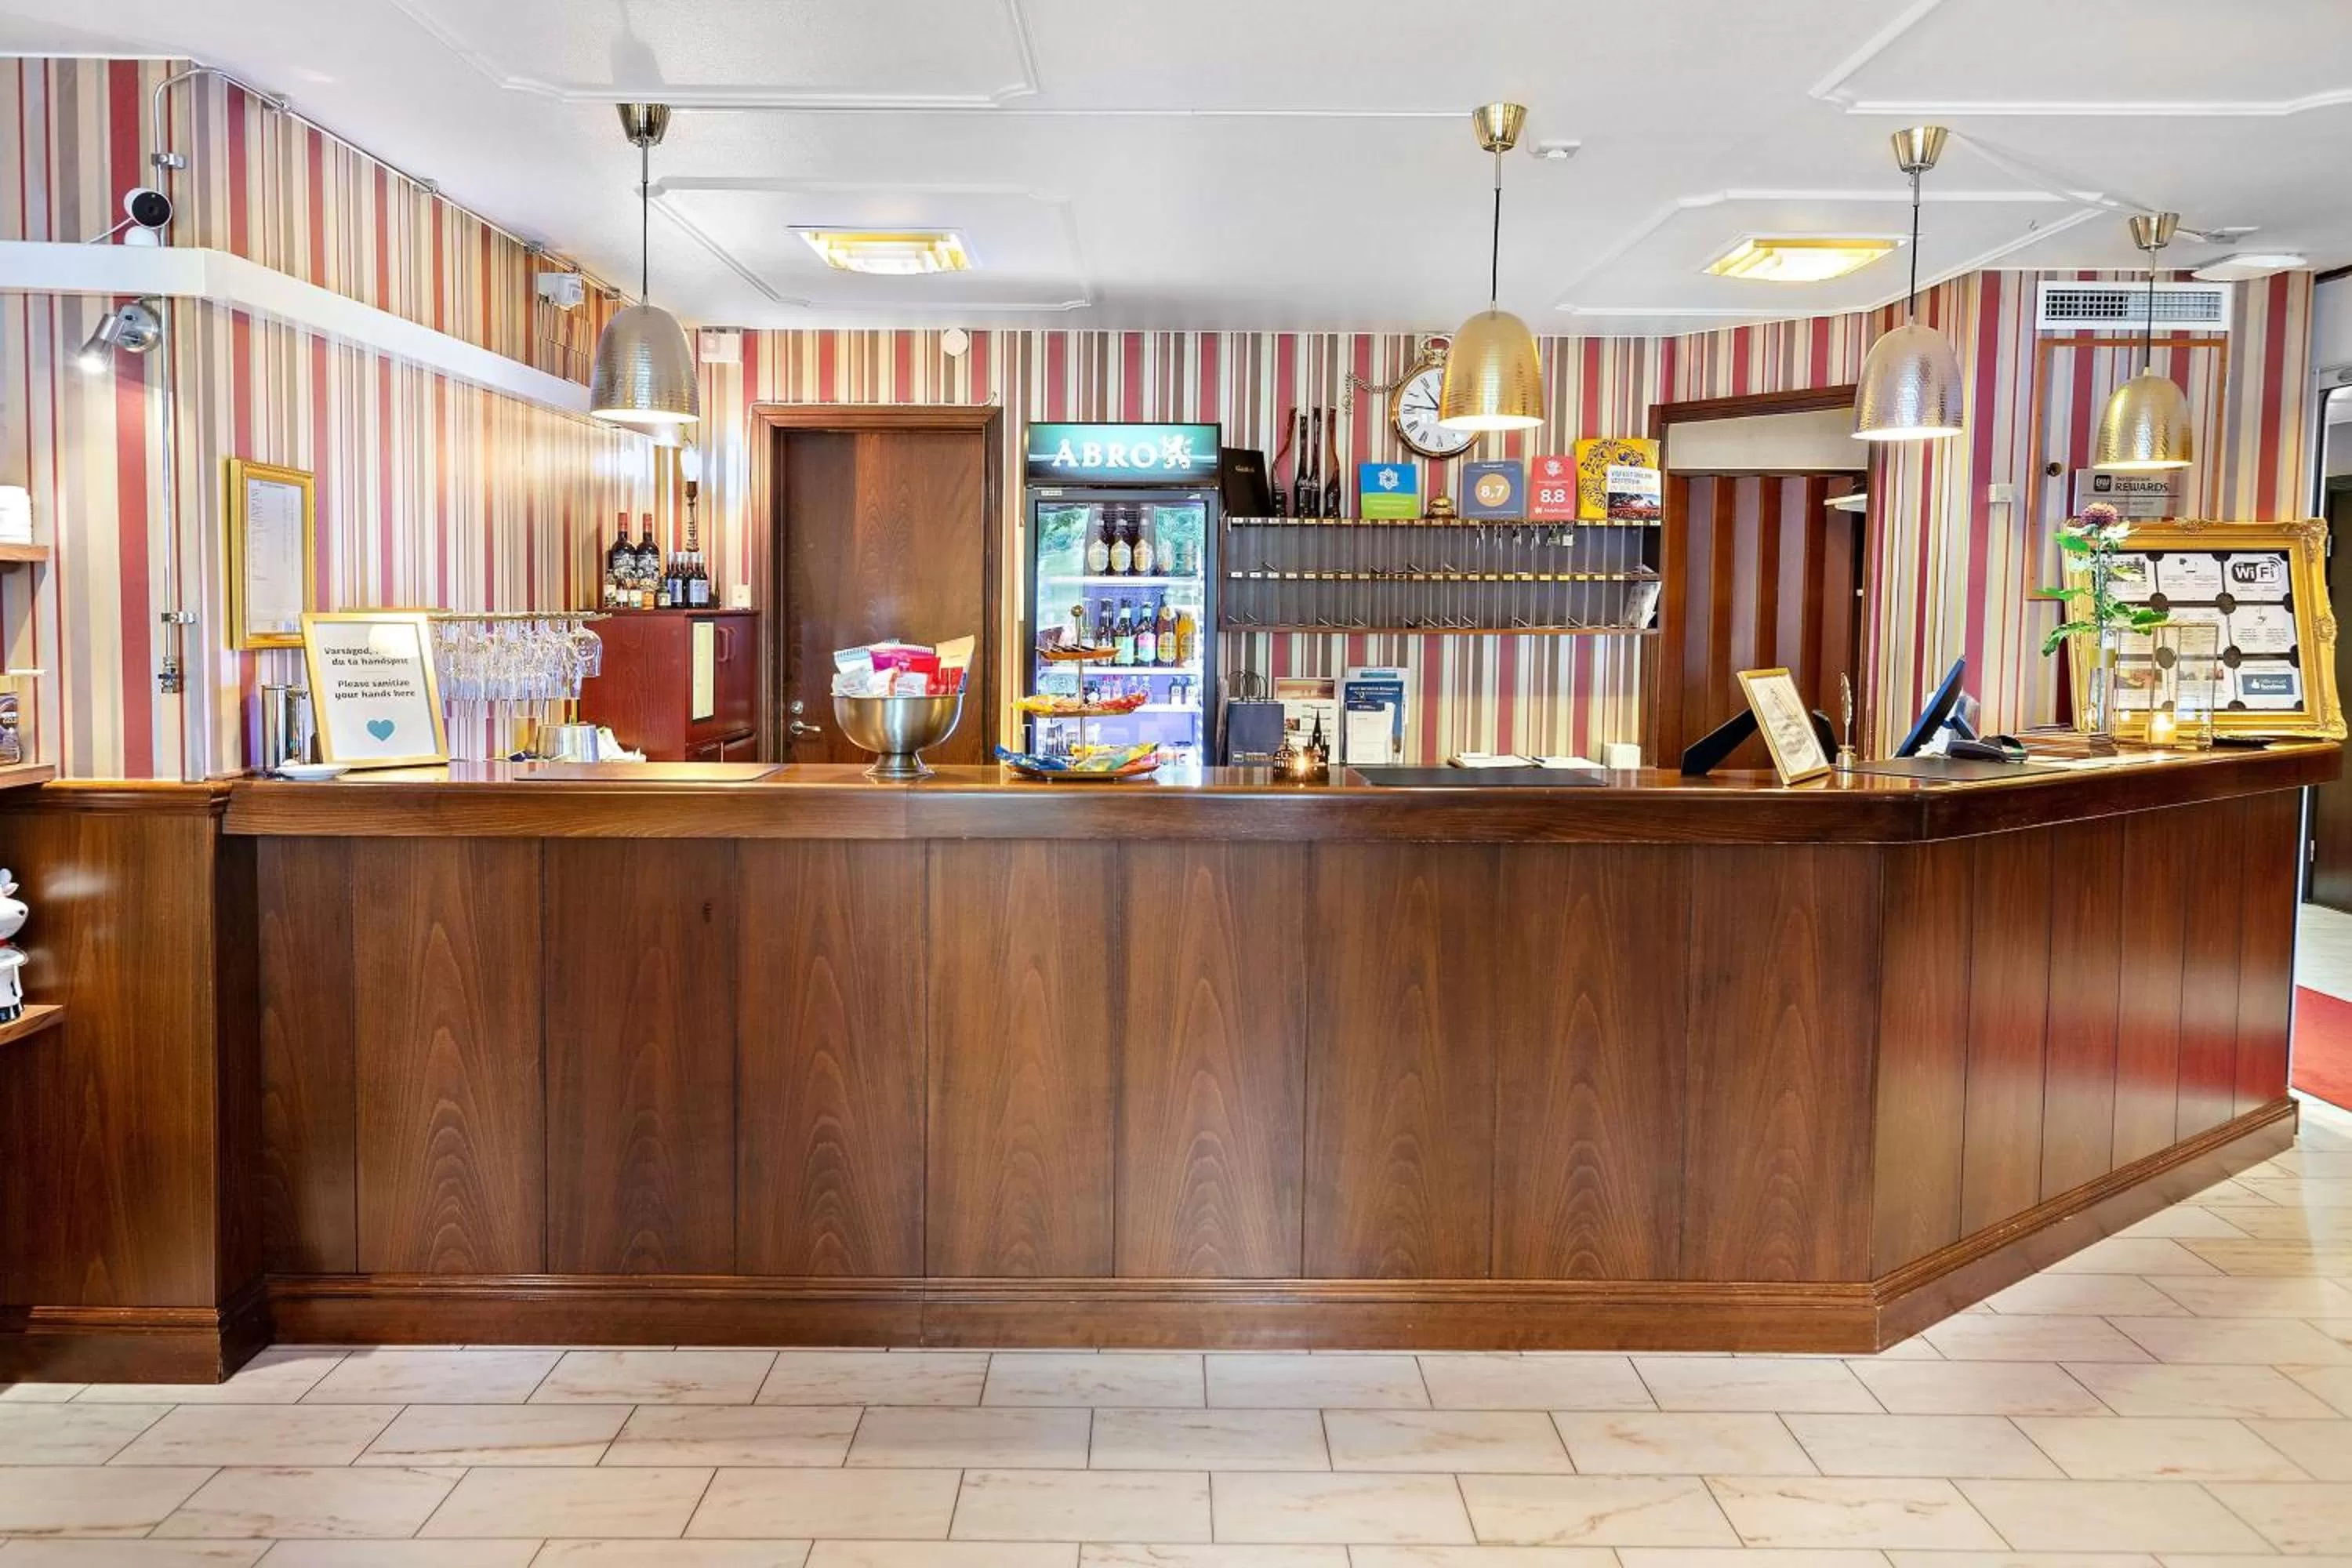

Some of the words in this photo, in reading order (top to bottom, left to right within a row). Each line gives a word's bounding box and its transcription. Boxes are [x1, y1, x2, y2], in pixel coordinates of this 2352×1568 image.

[1051, 438, 1158, 468] ÅBRO
[1480, 485, 1505, 499] 8,7
[2114, 482, 2169, 492] REWARDS
[1540, 488, 1566, 506] 8,8
[2235, 566, 2275, 580] WiFi
[361, 690, 391, 699] hands
[393, 688, 416, 698] here
